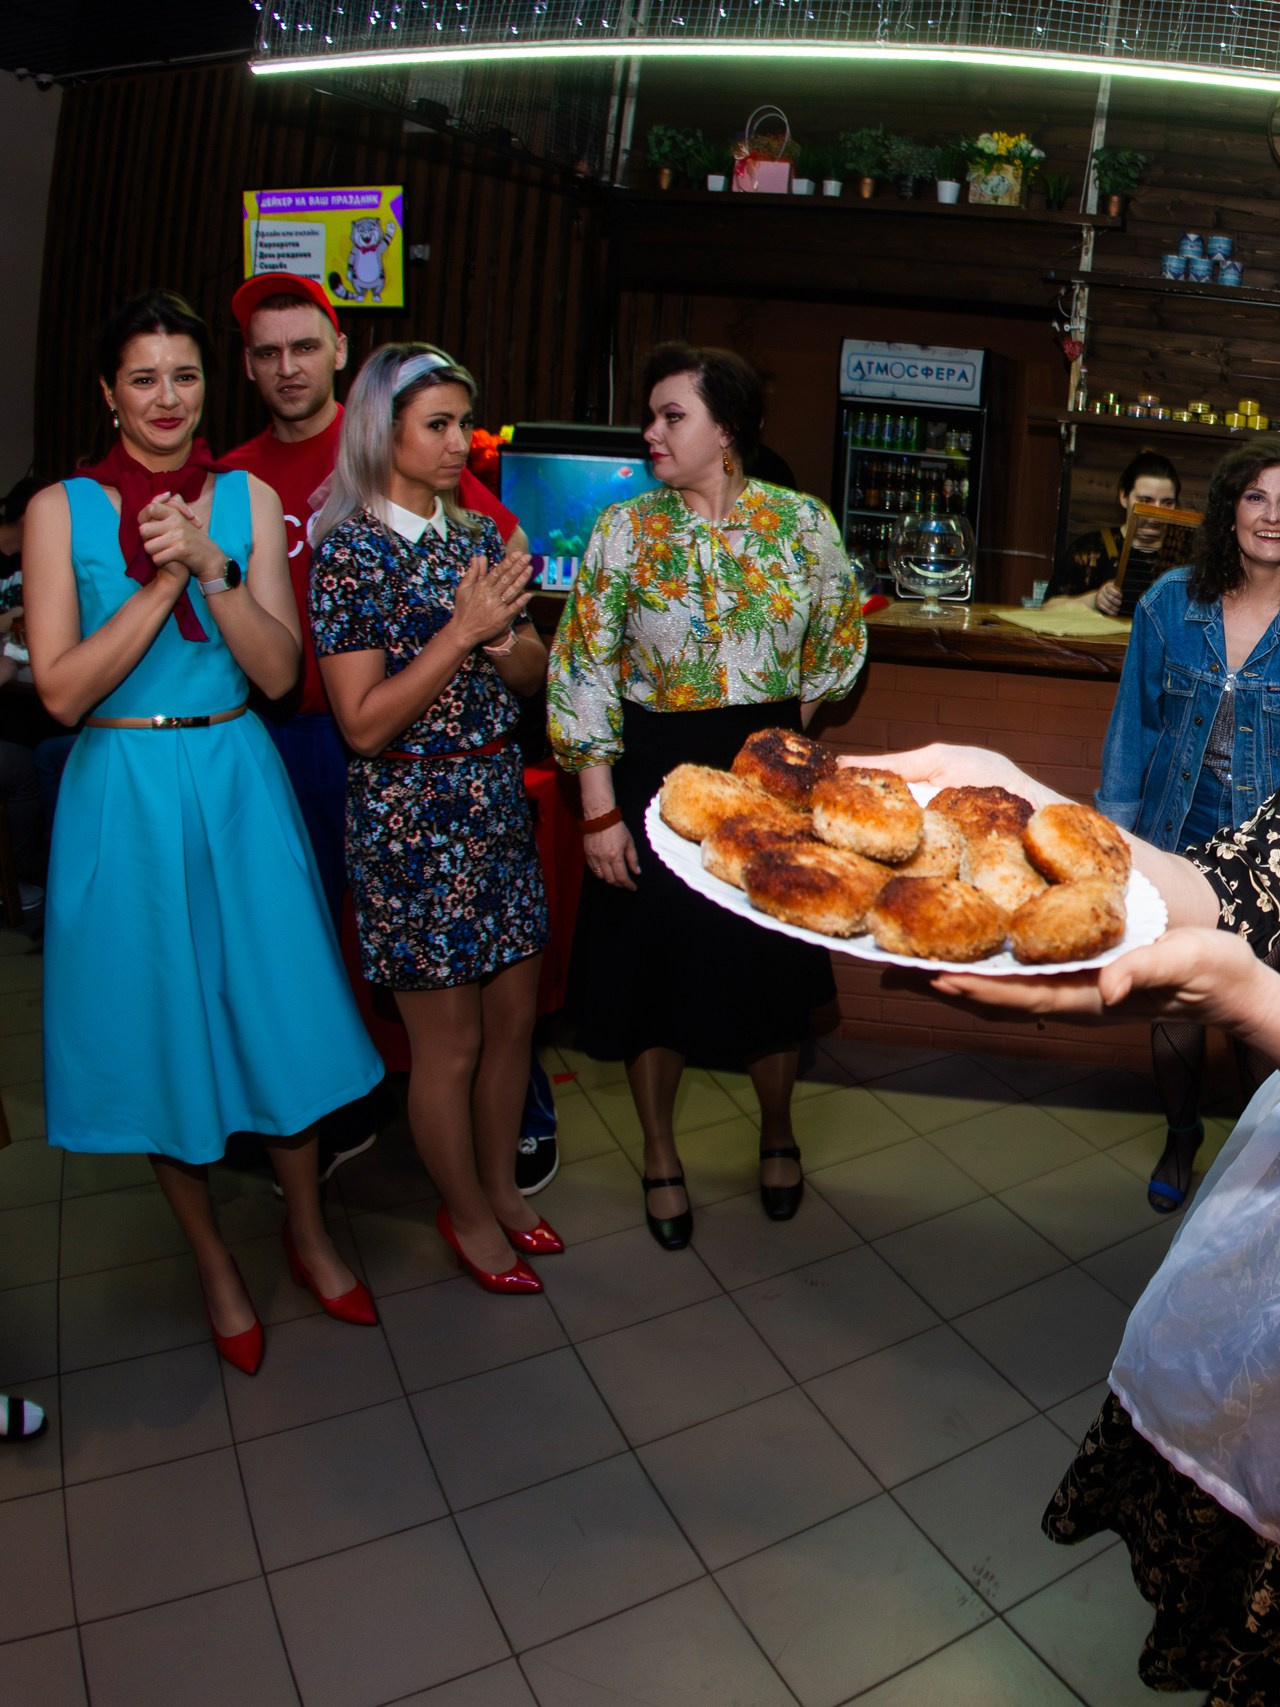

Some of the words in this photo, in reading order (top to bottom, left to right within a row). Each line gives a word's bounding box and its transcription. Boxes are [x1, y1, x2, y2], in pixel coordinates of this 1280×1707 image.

[295, 196, 307, 206] НА
[308, 195, 329, 206] ВАШ
[331, 194, 378, 206] ПРАЗДНИК
[852, 360, 970, 383] АТМОСФЕРА
